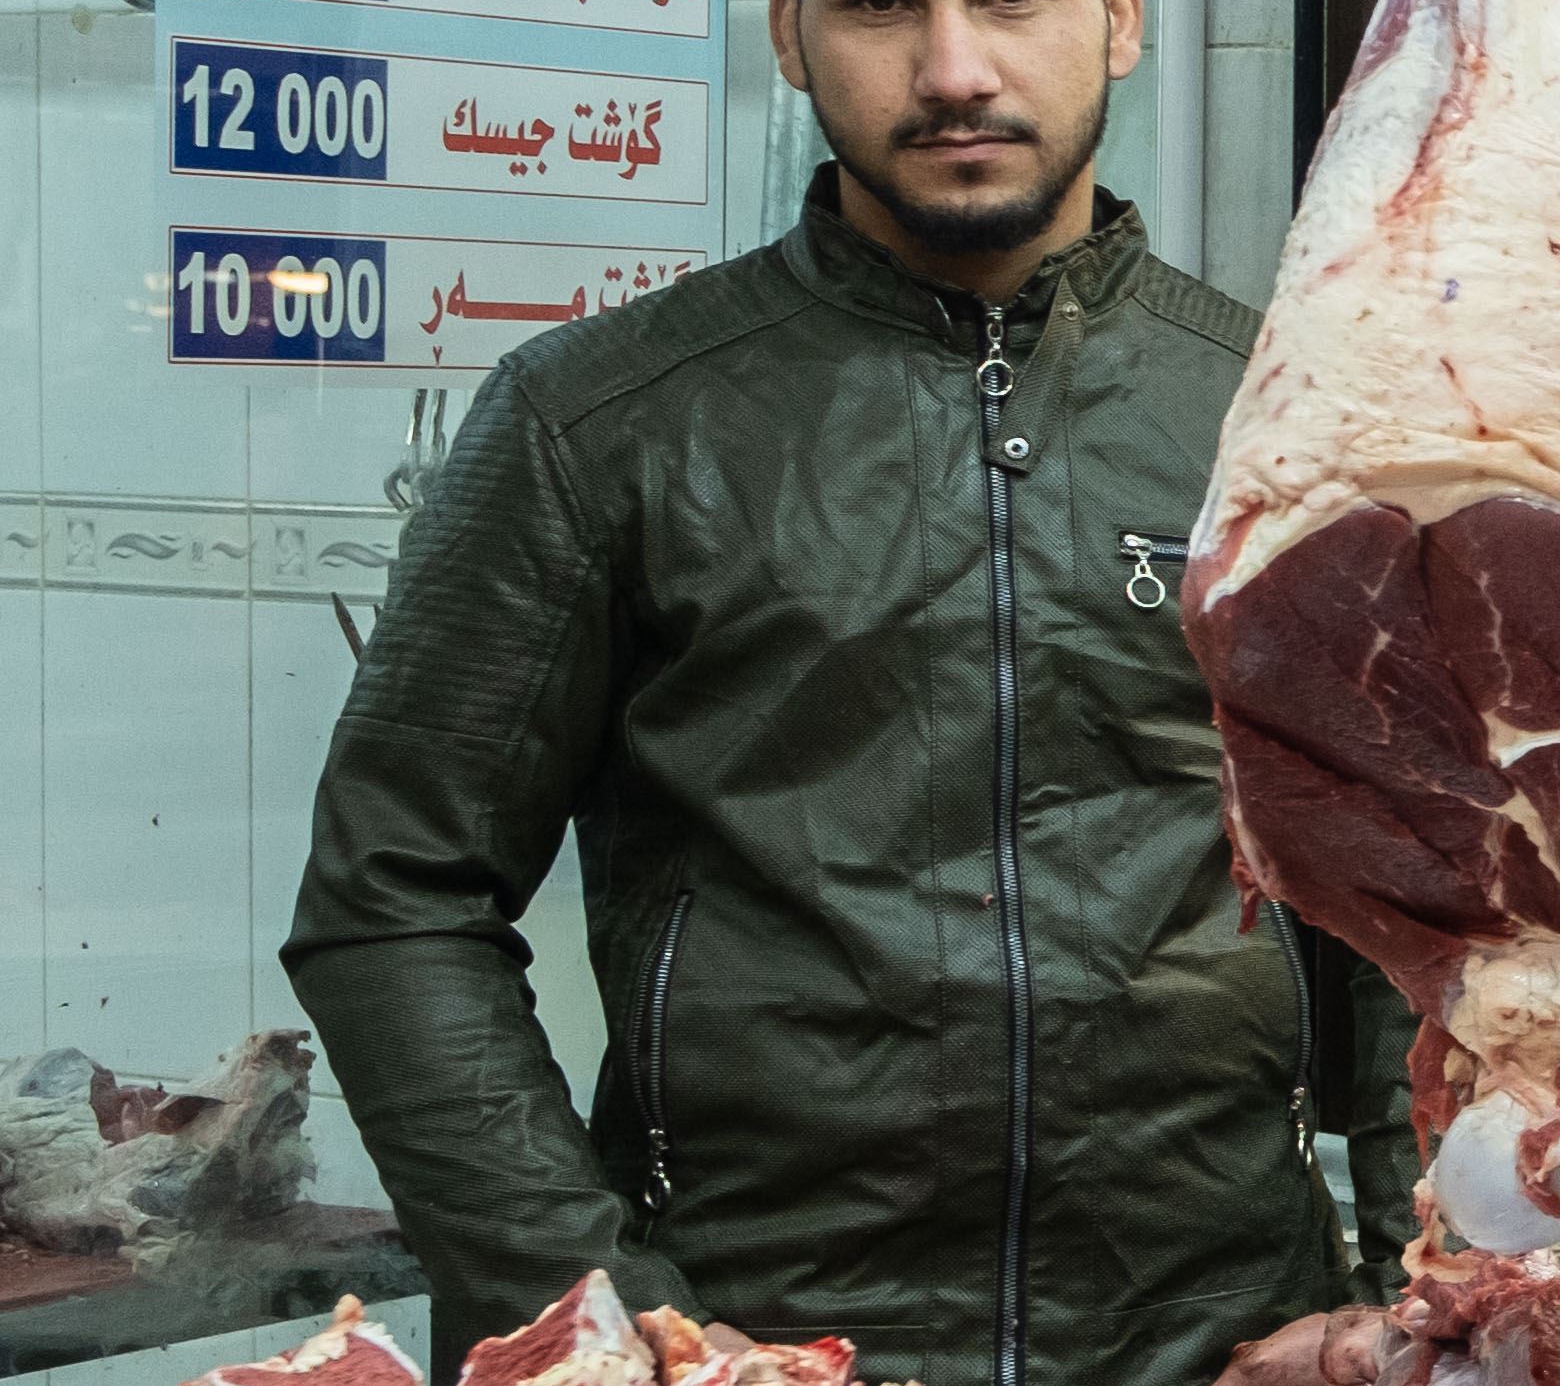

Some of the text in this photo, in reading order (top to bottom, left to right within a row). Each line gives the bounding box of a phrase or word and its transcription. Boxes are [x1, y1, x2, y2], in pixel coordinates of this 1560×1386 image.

[183, 65, 385, 160] 12 000
[567, 98, 662, 180] گۆشت
[179, 252, 380, 339] 10 000
